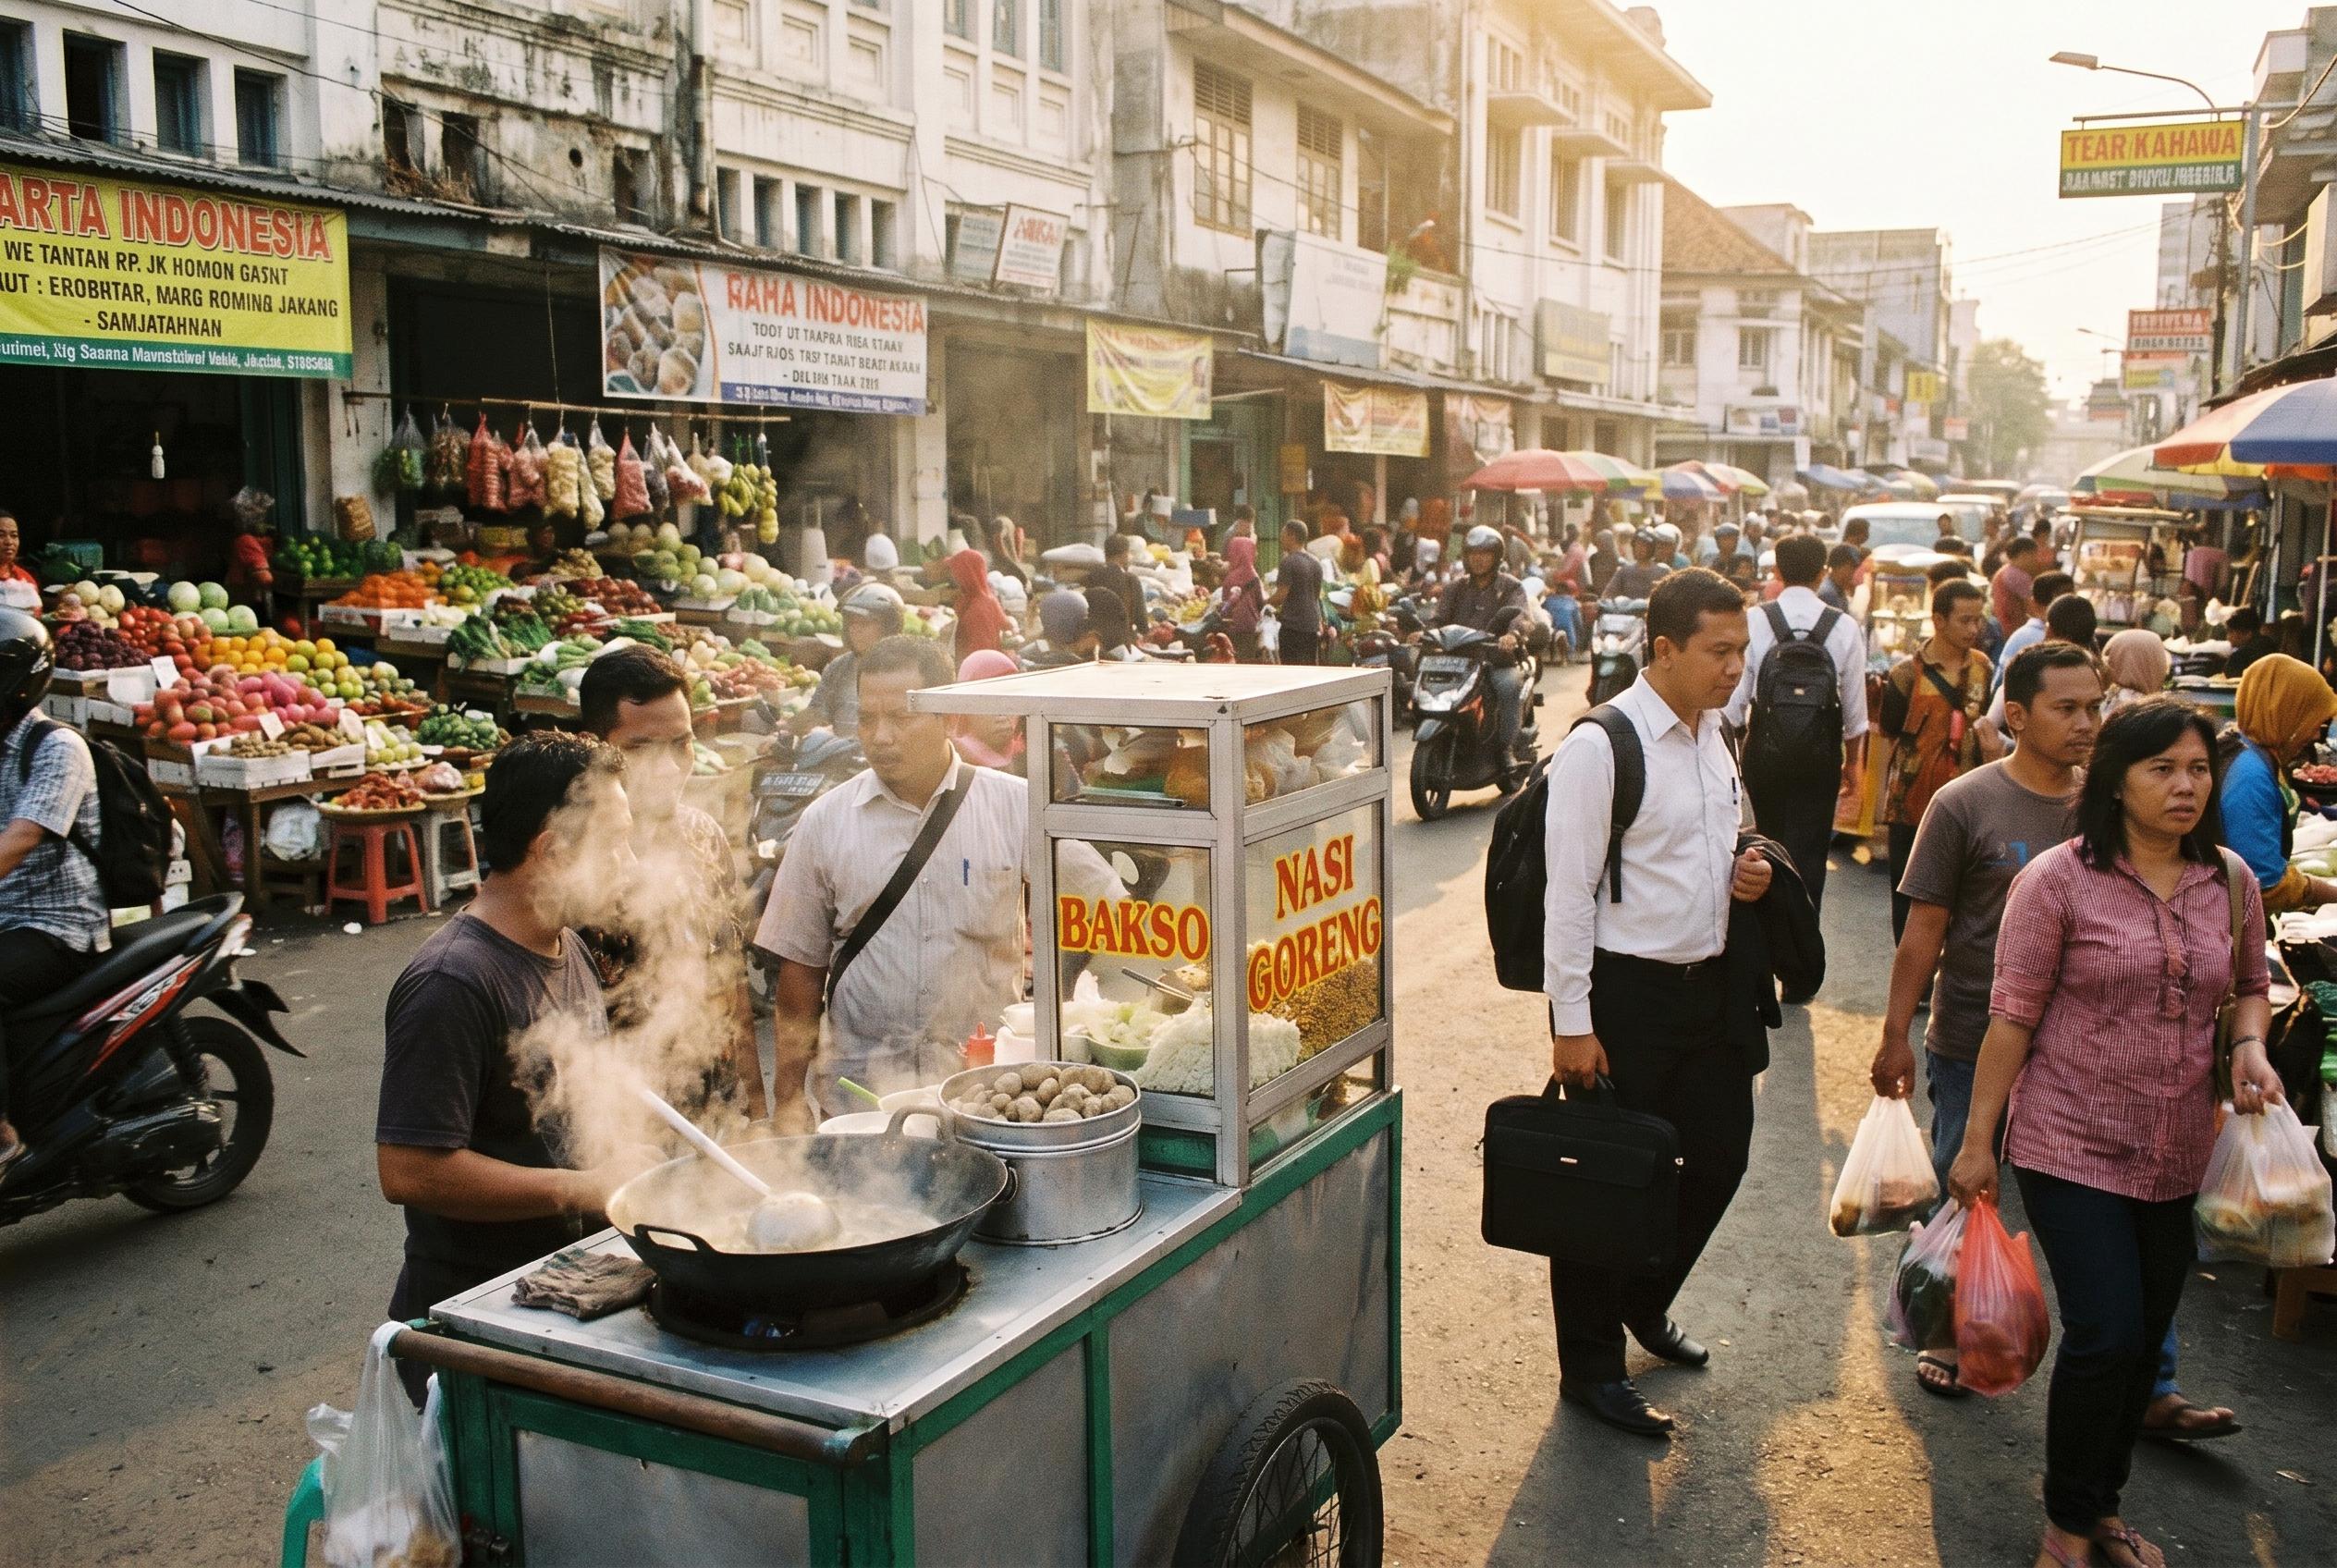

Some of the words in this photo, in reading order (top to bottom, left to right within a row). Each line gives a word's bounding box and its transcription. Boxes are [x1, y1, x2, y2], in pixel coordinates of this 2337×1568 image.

[0, 172, 110, 239] ARTA
[118, 188, 333, 263] INDONESIA
[5, 240, 34, 263] WE
[39, 243, 110, 270] TANTAN
[116, 251, 141, 273] RP.
[146, 254, 168, 276] JK
[173, 257, 235, 281] HOMON
[156, 285, 202, 307] MARG
[279, 296, 338, 317] JAKANG
[805, 281, 925, 335] INDONESIA
[1274, 833, 1354, 920] NASI
[1058, 894, 1210, 962] BAKSO
[1247, 896, 1383, 1012] GORENG
